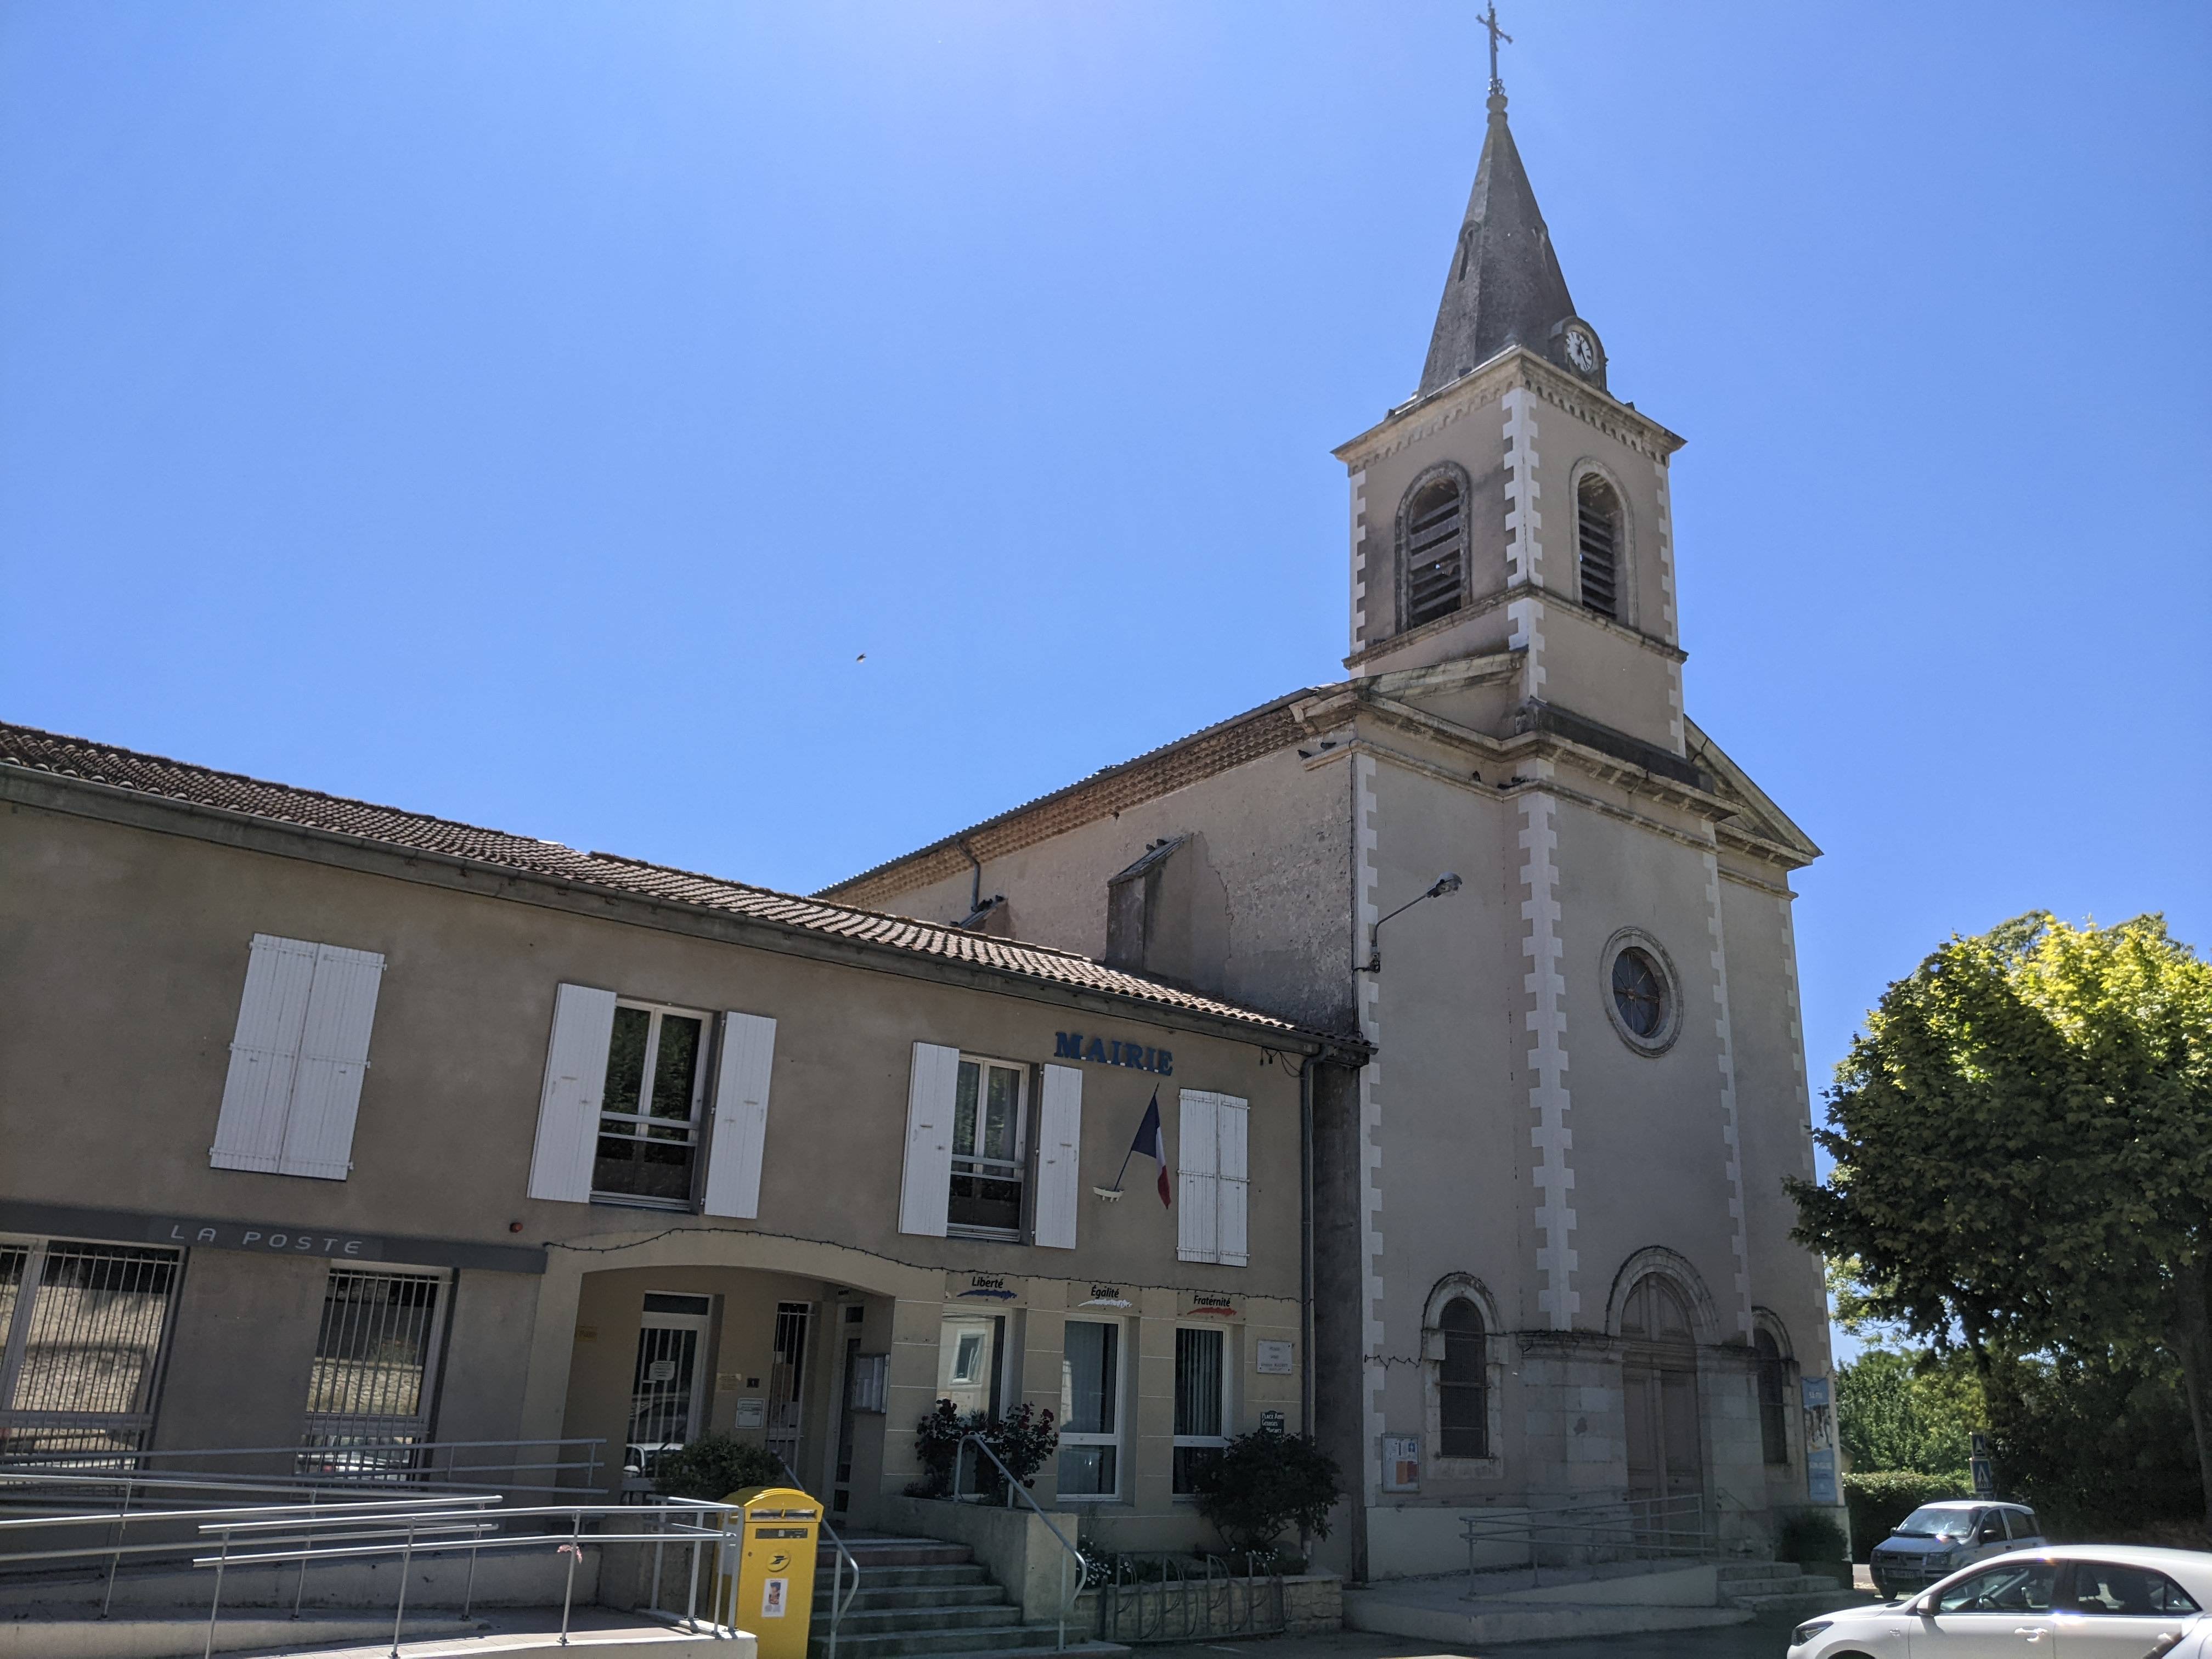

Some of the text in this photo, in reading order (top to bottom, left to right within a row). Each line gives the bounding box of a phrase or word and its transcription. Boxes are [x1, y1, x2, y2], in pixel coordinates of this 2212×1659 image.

[1054, 1032, 1173, 1076] MAIRIE
[170, 1224, 363, 1254] LA POSTE
[972, 1276, 1004, 1289] Liberté
[1090, 1285, 1120, 1299] Égalité
[1193, 1295, 1231, 1308] Fraternité
